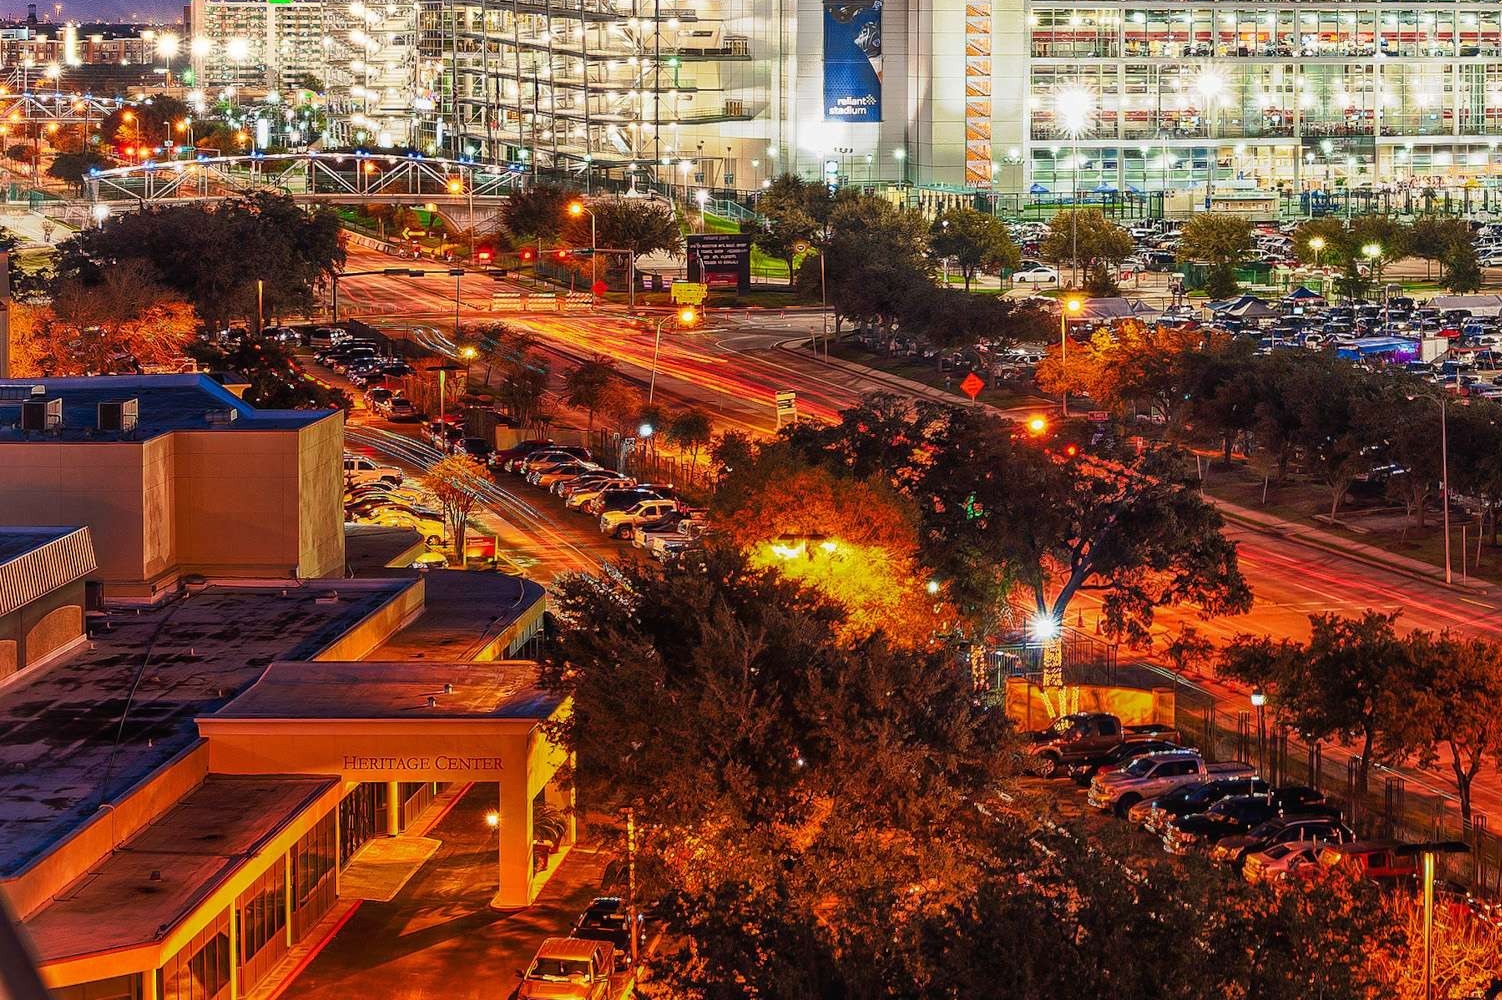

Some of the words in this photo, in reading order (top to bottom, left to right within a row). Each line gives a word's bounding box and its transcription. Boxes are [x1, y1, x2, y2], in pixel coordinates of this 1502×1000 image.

[837, 96, 867, 106] reliant
[829, 106, 867, 115] stadium
[343, 755, 431, 770] HERITAGE
[435, 755, 504, 770] CENTER
